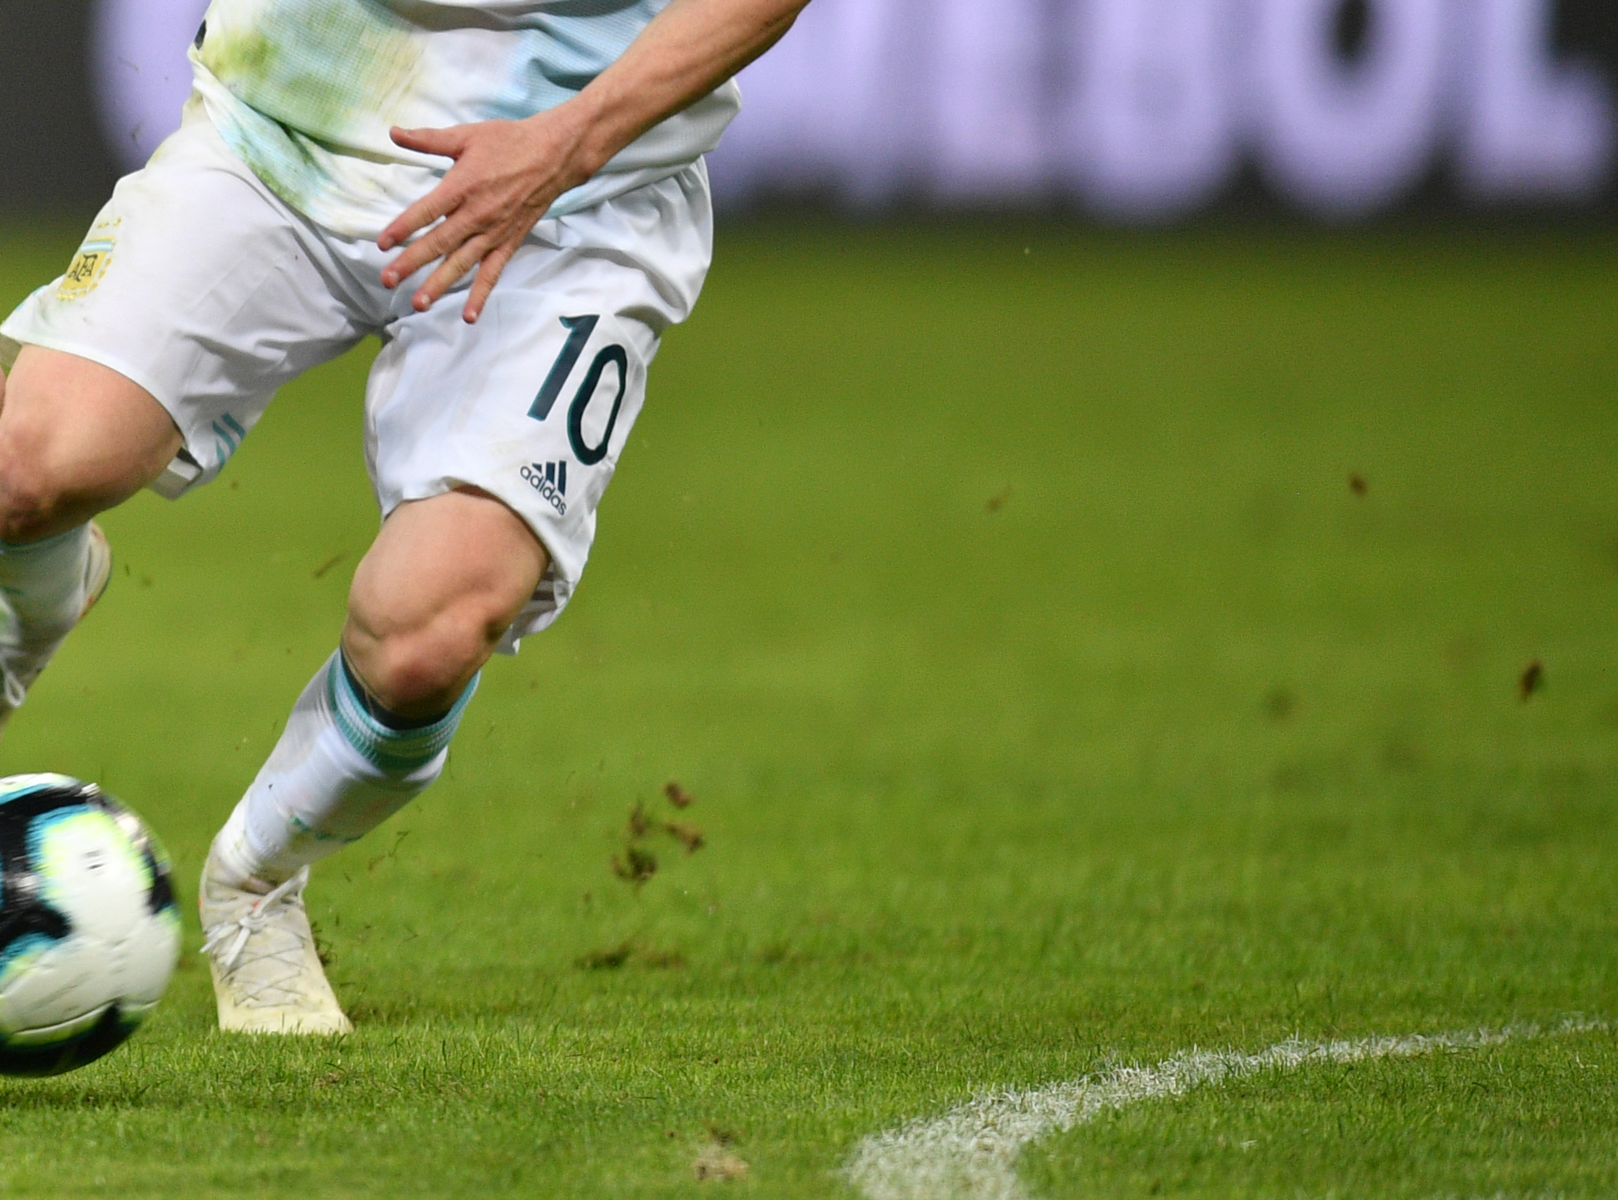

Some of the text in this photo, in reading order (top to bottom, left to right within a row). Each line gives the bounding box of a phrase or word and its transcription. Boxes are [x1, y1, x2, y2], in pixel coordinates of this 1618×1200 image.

[68, 254, 98, 282] AFA
[526, 314, 628, 466] 10
[520, 465, 567, 516] adidas
